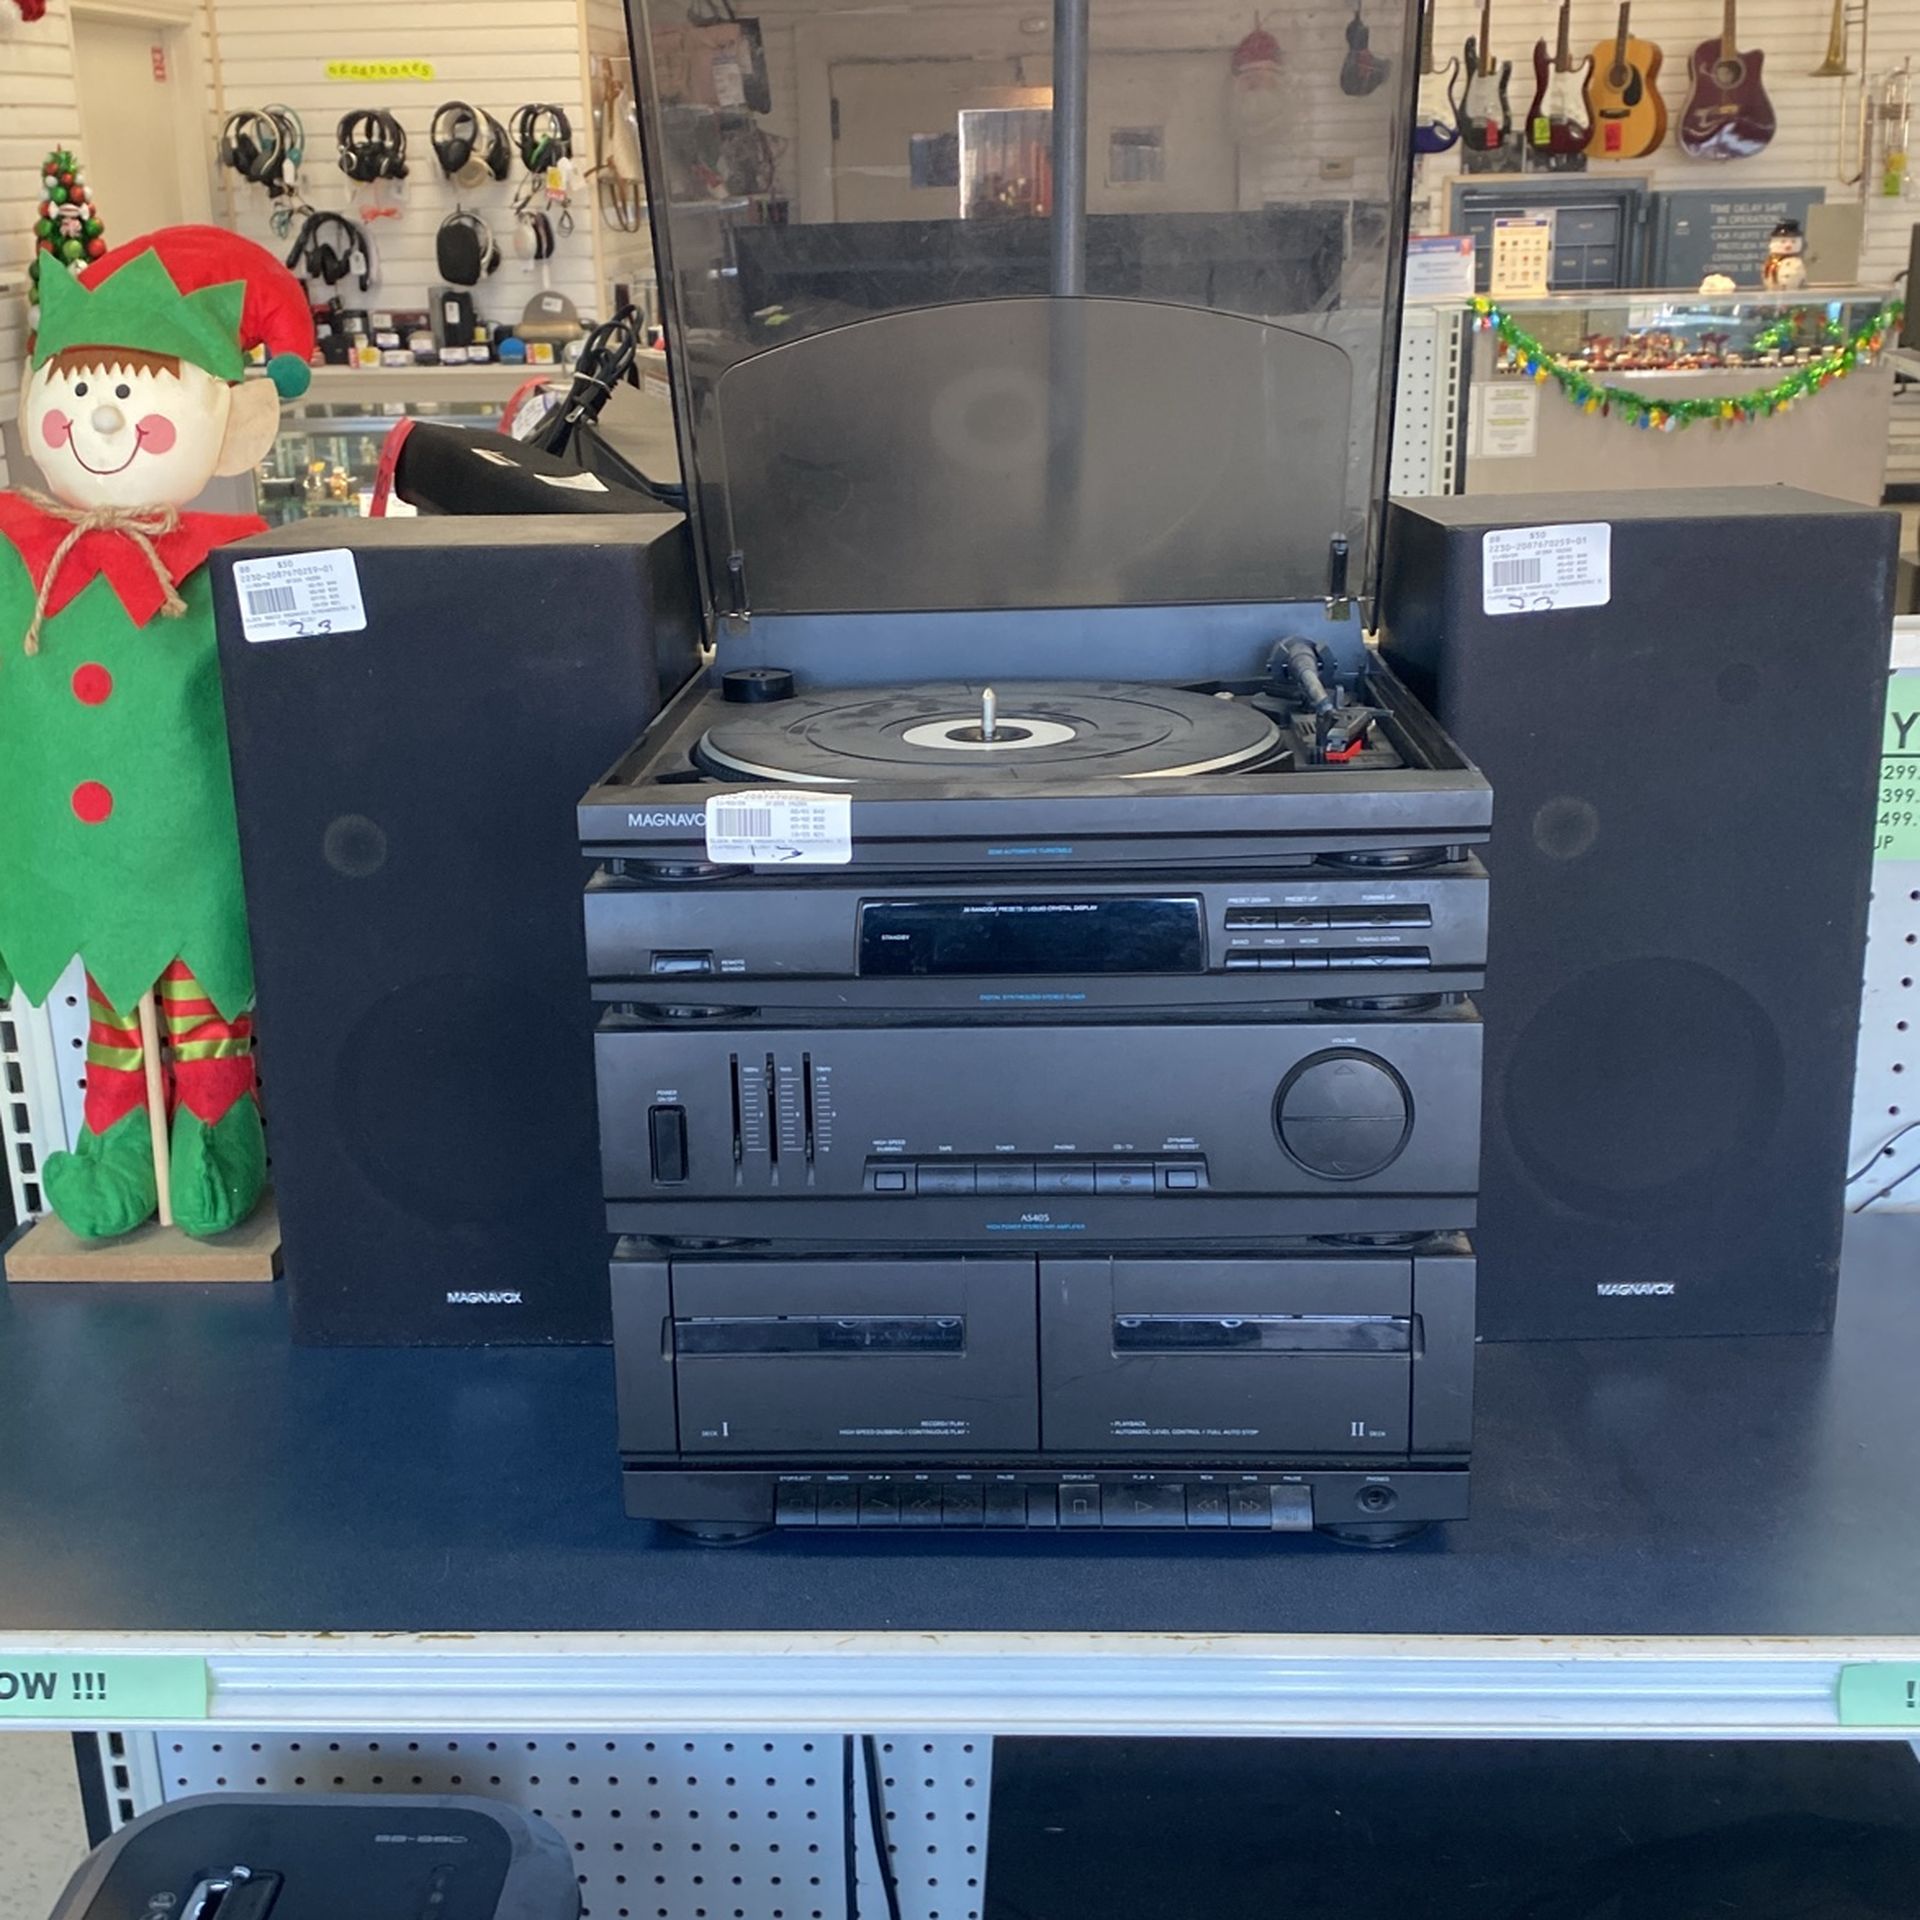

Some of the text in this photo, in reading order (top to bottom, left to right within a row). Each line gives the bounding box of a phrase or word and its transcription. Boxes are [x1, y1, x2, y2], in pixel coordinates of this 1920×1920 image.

[627, 813, 706, 827] MAGNAVO
[1597, 1282, 1675, 1296] MAGNAVOX
[446, 1290, 523, 1304] MAGNAVOX
[72, 1672, 106, 1700] !!!
